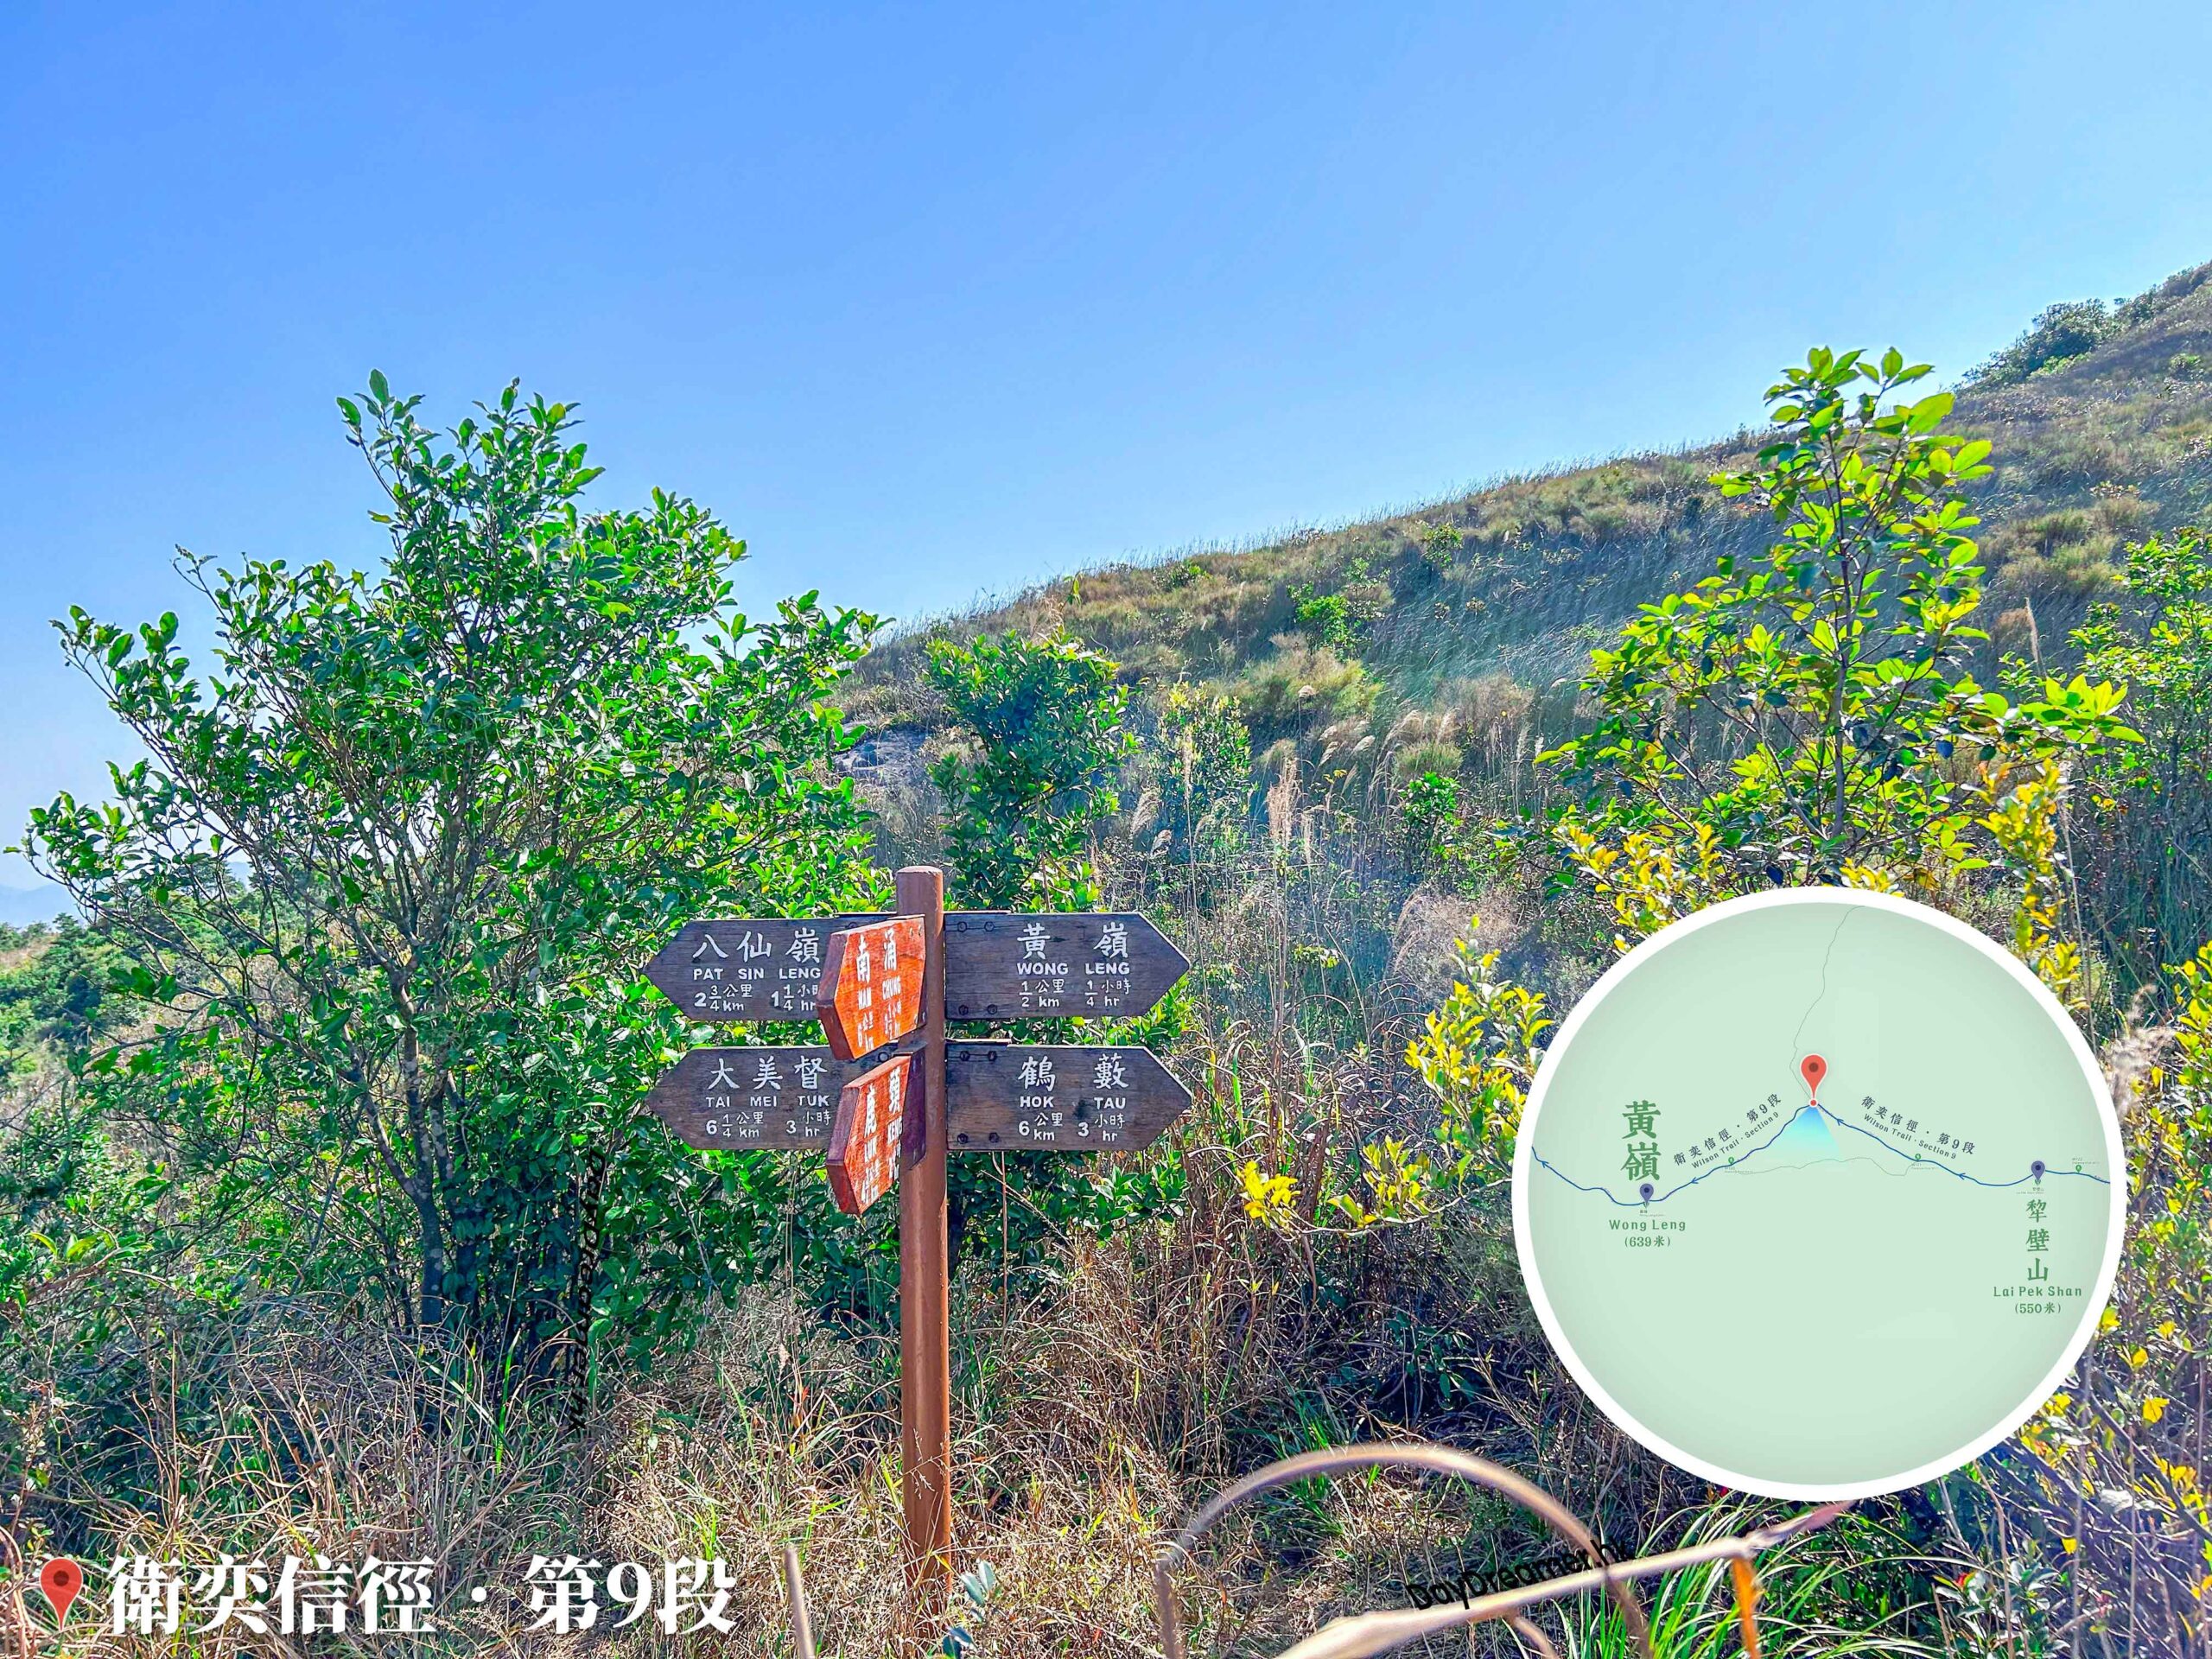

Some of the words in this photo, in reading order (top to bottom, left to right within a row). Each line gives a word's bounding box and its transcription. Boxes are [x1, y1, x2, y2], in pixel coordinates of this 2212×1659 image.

[692, 927, 820, 963] 八仙嶺
[693, 968, 724, 981] PAT
[737, 968, 765, 981] SIN
[779, 968, 821, 980] LENG
[1017, 963, 1069, 975] WONG
[1084, 963, 1130, 975] LENG
[723, 983, 753, 998] 公里
[882, 976, 901, 1001] CHUNG
[1035, 978, 1065, 994] 公里
[1101, 977, 1131, 995] 小時
[722, 1000, 745, 1012] km
[1039, 996, 1060, 1007] km
[1104, 996, 1120, 1007] hr
[708, 1055, 828, 1090] 大美督
[706, 1096, 730, 1108] TAI
[750, 1096, 777, 1107] MEI
[797, 1095, 830, 1106] TUK
[1020, 1096, 1054, 1108] HOK
[1094, 1097, 1126, 1110] TAU
[736, 1111, 764, 1124] 公里
[786, 1121, 797, 1135] 3
[803, 1109, 831, 1125] 小時
[1018, 1121, 1030, 1136] 6
[1034, 1112, 1063, 1127] 公里
[1077, 1122, 1090, 1137] 3
[1095, 1113, 1126, 1129] 小時
[739, 1128, 760, 1138] km
[805, 1127, 820, 1137] hr
[1033, 1129, 1055, 1141] km
[1103, 1130, 1118, 1141] hr
